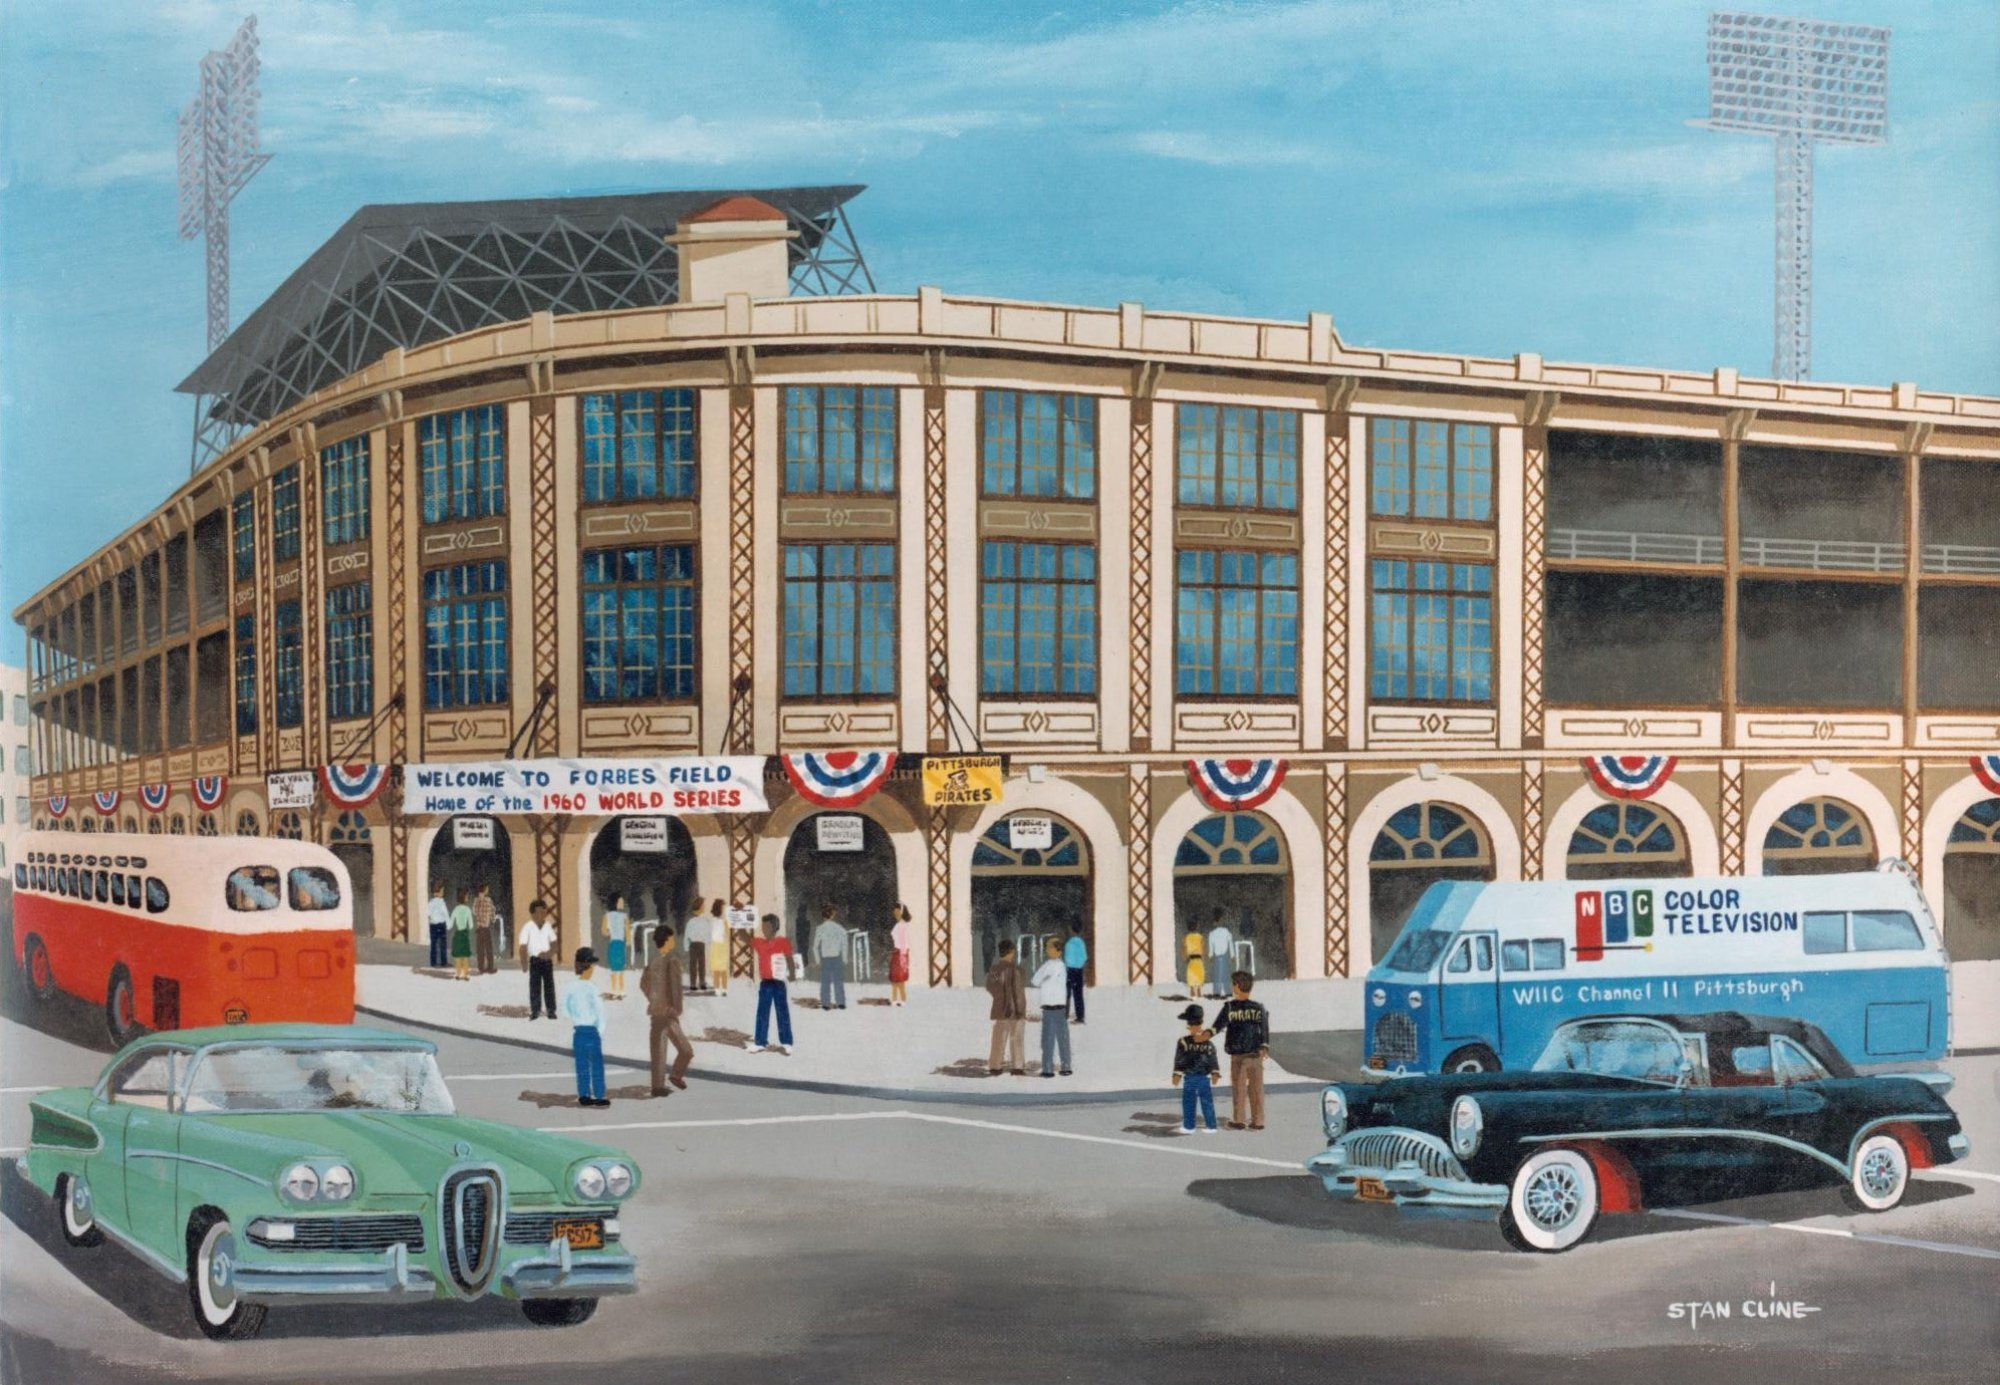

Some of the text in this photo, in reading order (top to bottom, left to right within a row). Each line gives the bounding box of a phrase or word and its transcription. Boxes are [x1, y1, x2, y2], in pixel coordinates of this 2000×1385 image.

[926, 758, 1000, 770] PITTSBURGH
[417, 765, 731, 787] WELCOME TO FORBES FIELD
[425, 789, 741, 811] Home of the 1960 WORLD SERIES
[935, 788, 992, 802] PIRATES
[1664, 889, 1740, 911] COLOR
[1664, 911, 1798, 934] TELEVISION
[1578, 983, 1652, 1003] Channel
[1694, 979, 1804, 1002] Pittsburgh
[1667, 1280, 1822, 1330] STAN CLINE
